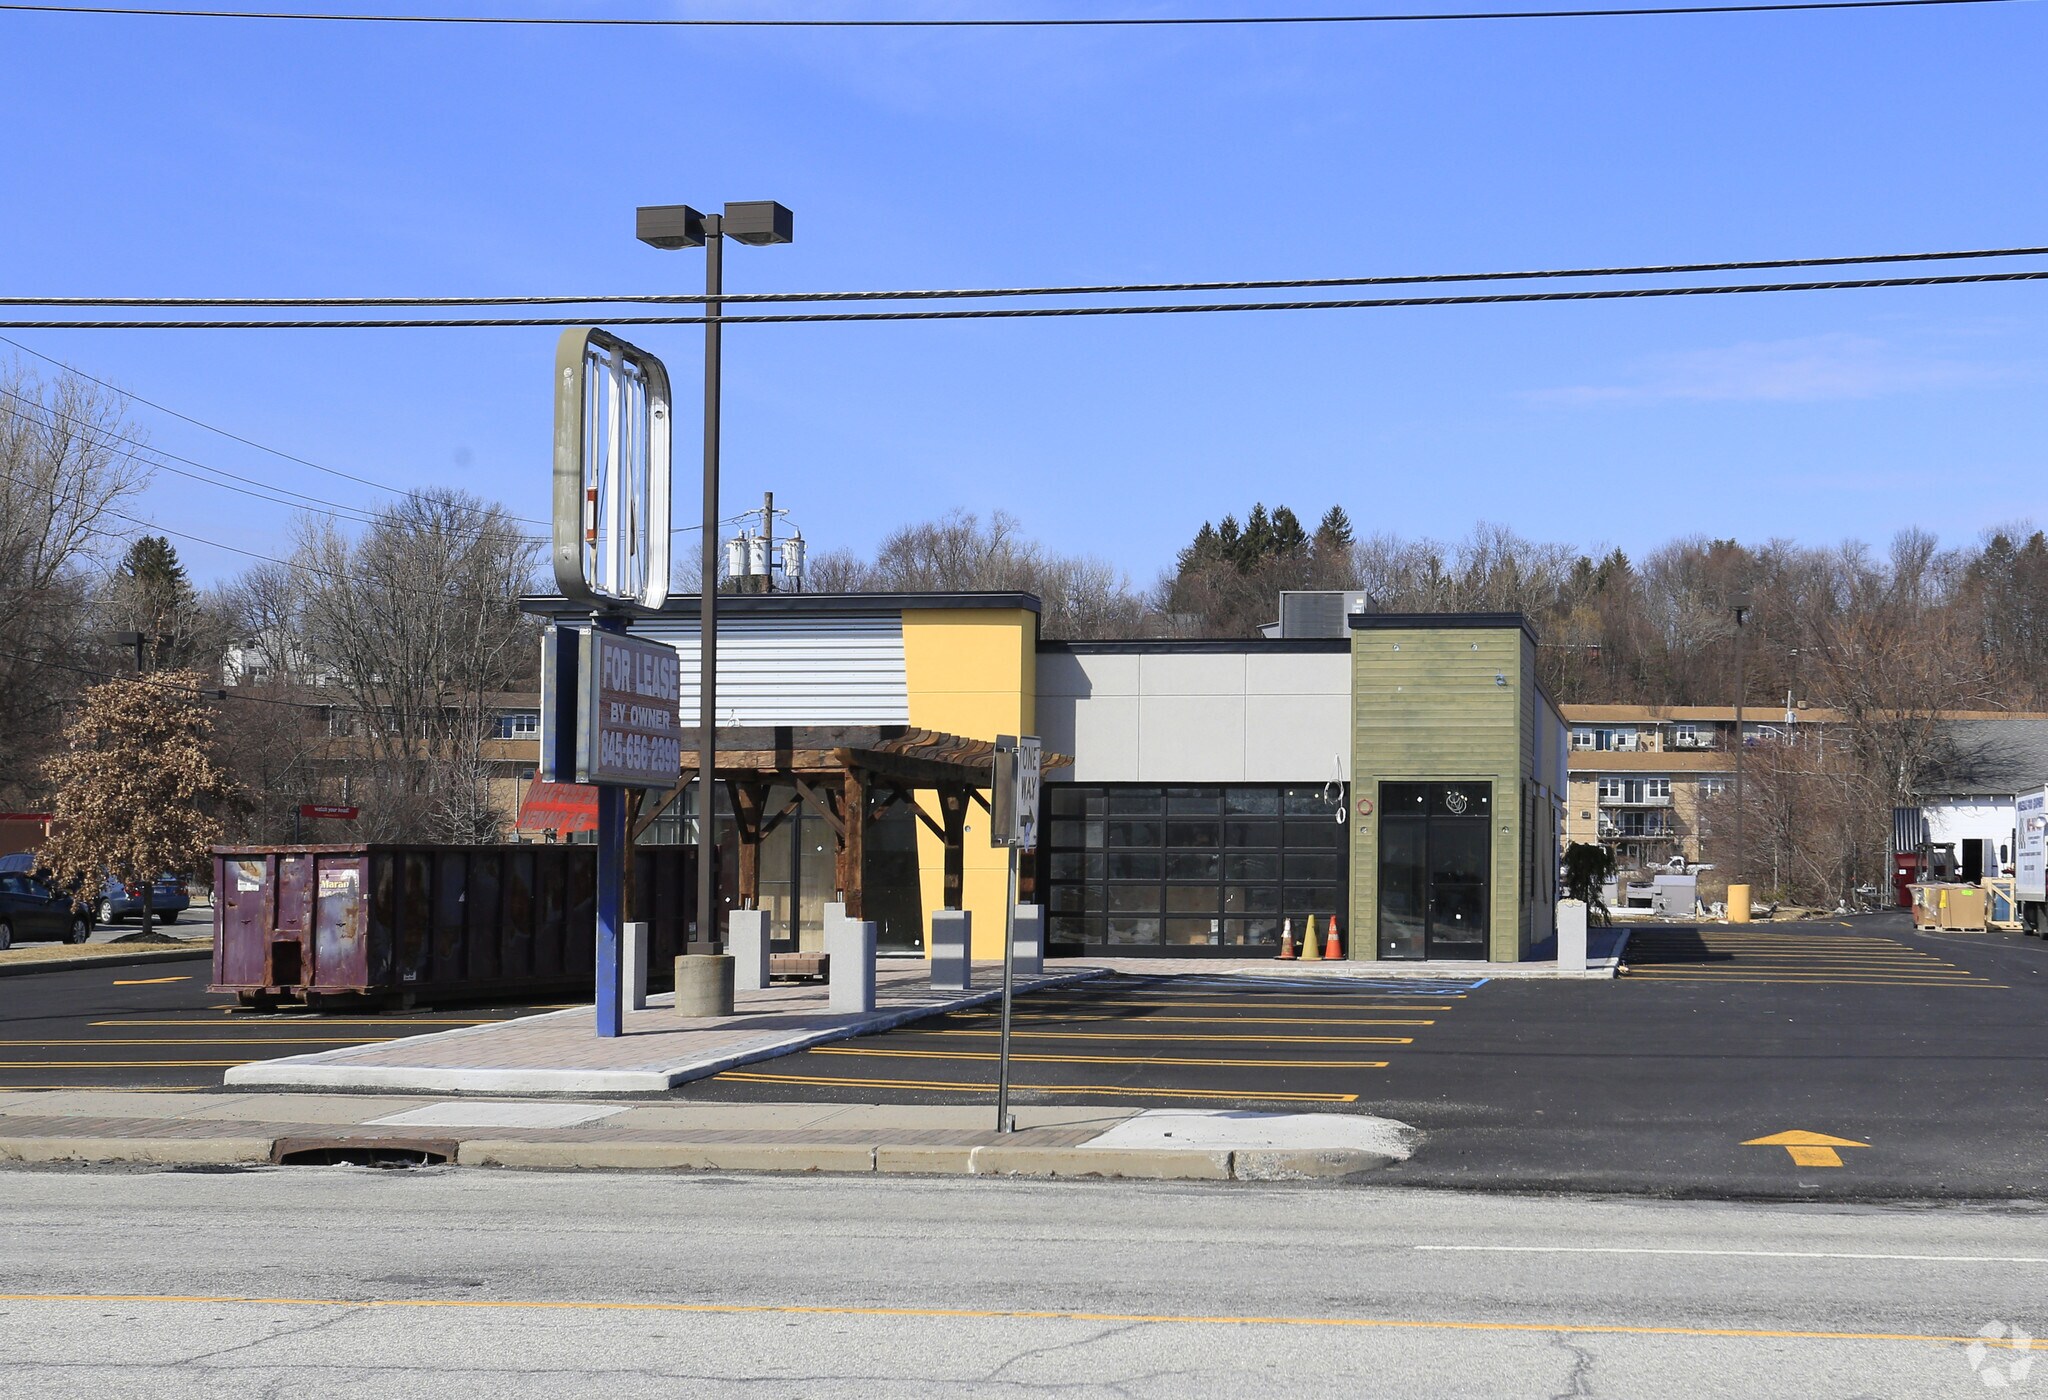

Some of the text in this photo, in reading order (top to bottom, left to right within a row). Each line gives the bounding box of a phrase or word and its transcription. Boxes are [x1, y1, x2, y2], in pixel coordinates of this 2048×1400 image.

[603, 646, 678, 701] FOR LEASE
[611, 702, 670, 730] BY OWNER
[601, 729, 679, 772] 845-656-2399
[1022, 747, 1036, 770] ONE
[1021, 777, 1036, 800] WAY
